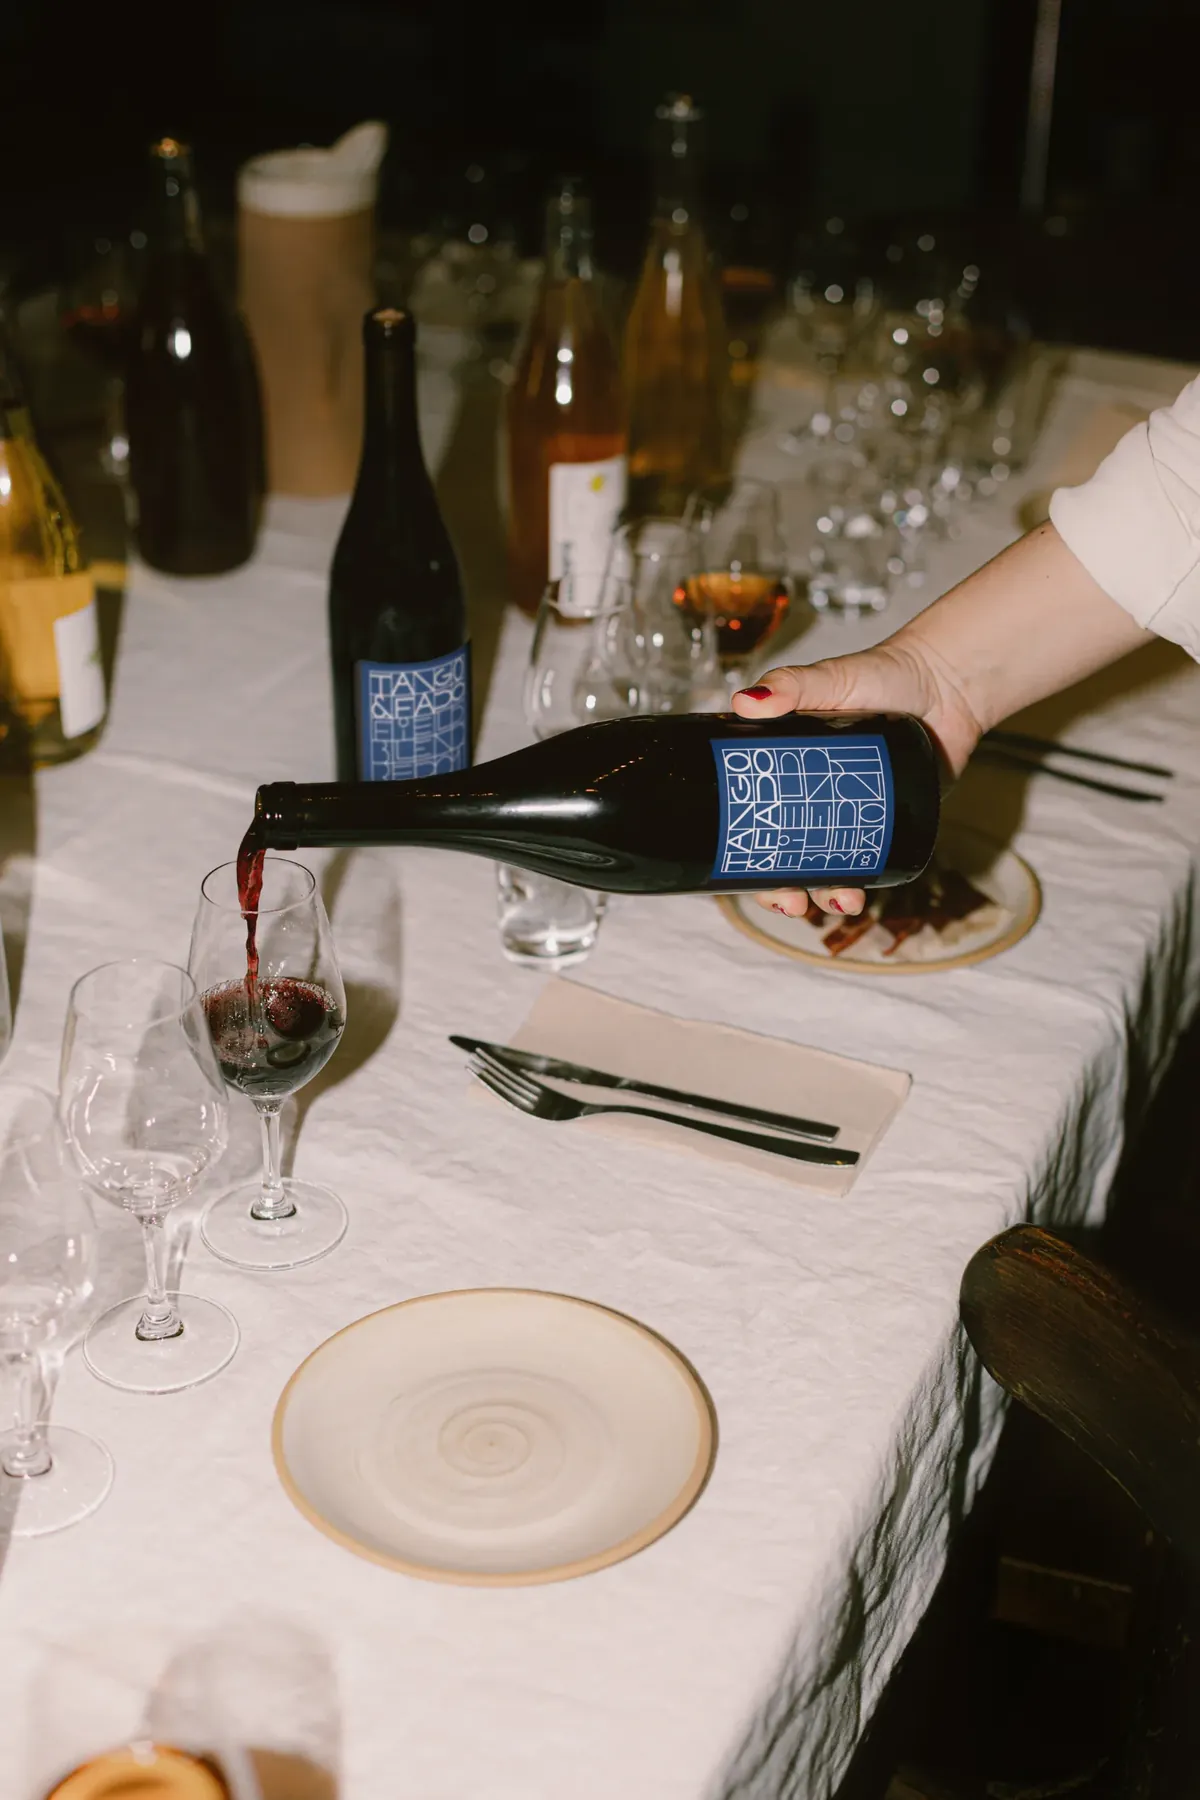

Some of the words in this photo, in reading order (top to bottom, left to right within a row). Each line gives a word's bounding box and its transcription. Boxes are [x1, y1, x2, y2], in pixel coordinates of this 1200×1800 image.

[369, 657, 465, 697] TANGO
[371, 694, 394, 719] &
[395, 682, 466, 720] FADO
[372, 723, 465, 764] BLEND
[725, 751, 756, 872] TANGO
[753, 749, 780, 850] FADO
[799, 748, 834, 870] BLEND
[747, 851, 777, 872] &
[826, 800, 858, 870] RED
